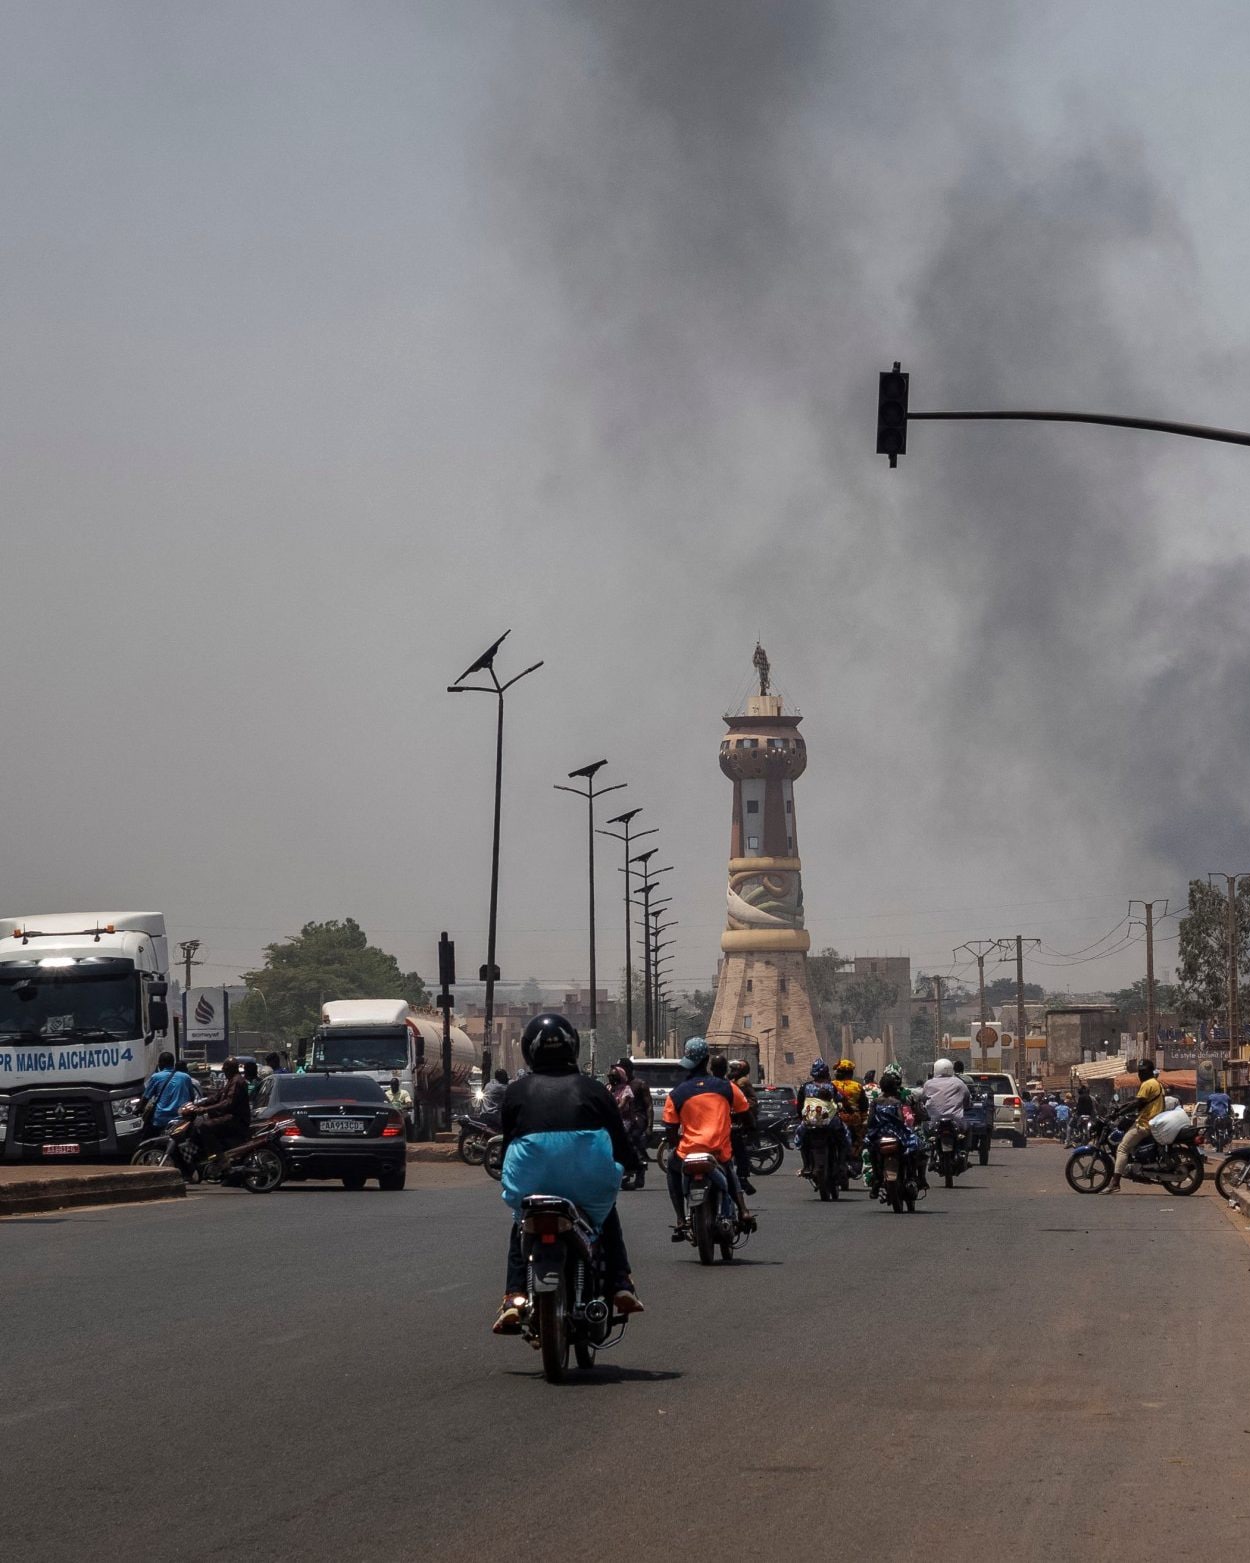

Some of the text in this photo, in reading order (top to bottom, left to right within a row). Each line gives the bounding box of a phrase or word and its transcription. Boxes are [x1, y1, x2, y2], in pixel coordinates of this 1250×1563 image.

[17, 1052, 55, 1072] MAIGA
[58, 1048, 119, 1070] AICHATOU
[121, 1048, 133, 1061] 4
[1180, 1051, 1196, 1060] style
